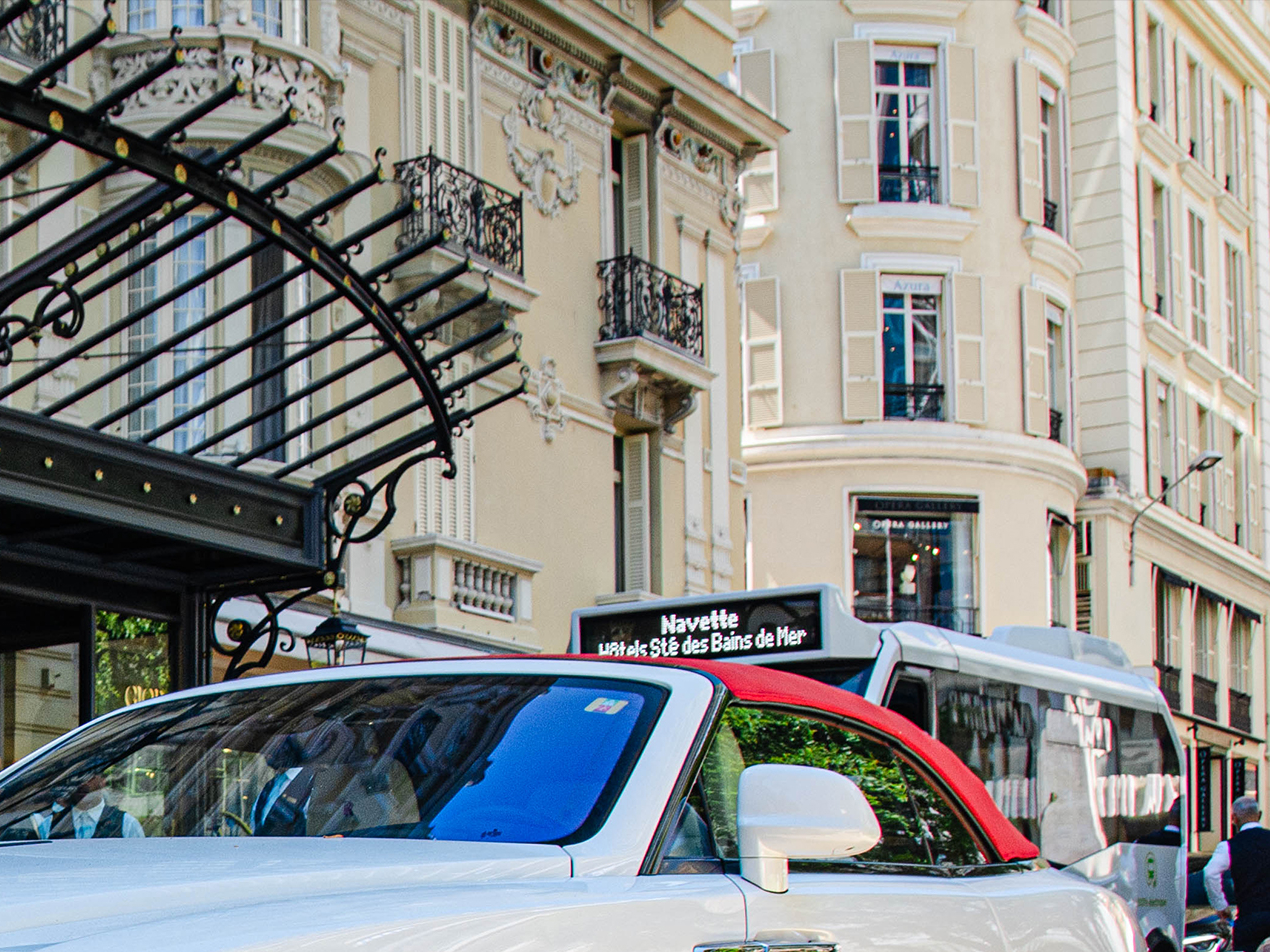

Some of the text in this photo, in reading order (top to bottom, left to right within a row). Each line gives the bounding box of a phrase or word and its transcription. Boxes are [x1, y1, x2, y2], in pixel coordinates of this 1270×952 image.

[893, 280, 930, 291] Azura
[872, 519, 949, 530] OPERA GALLERY
[660, 609, 740, 636] Navette
[649, 636, 680, 658] Sté
[682, 635, 709, 656] des
[711, 630, 753, 653] Bains
[755, 628, 774, 649] de
[776, 625, 808, 647] Mer
